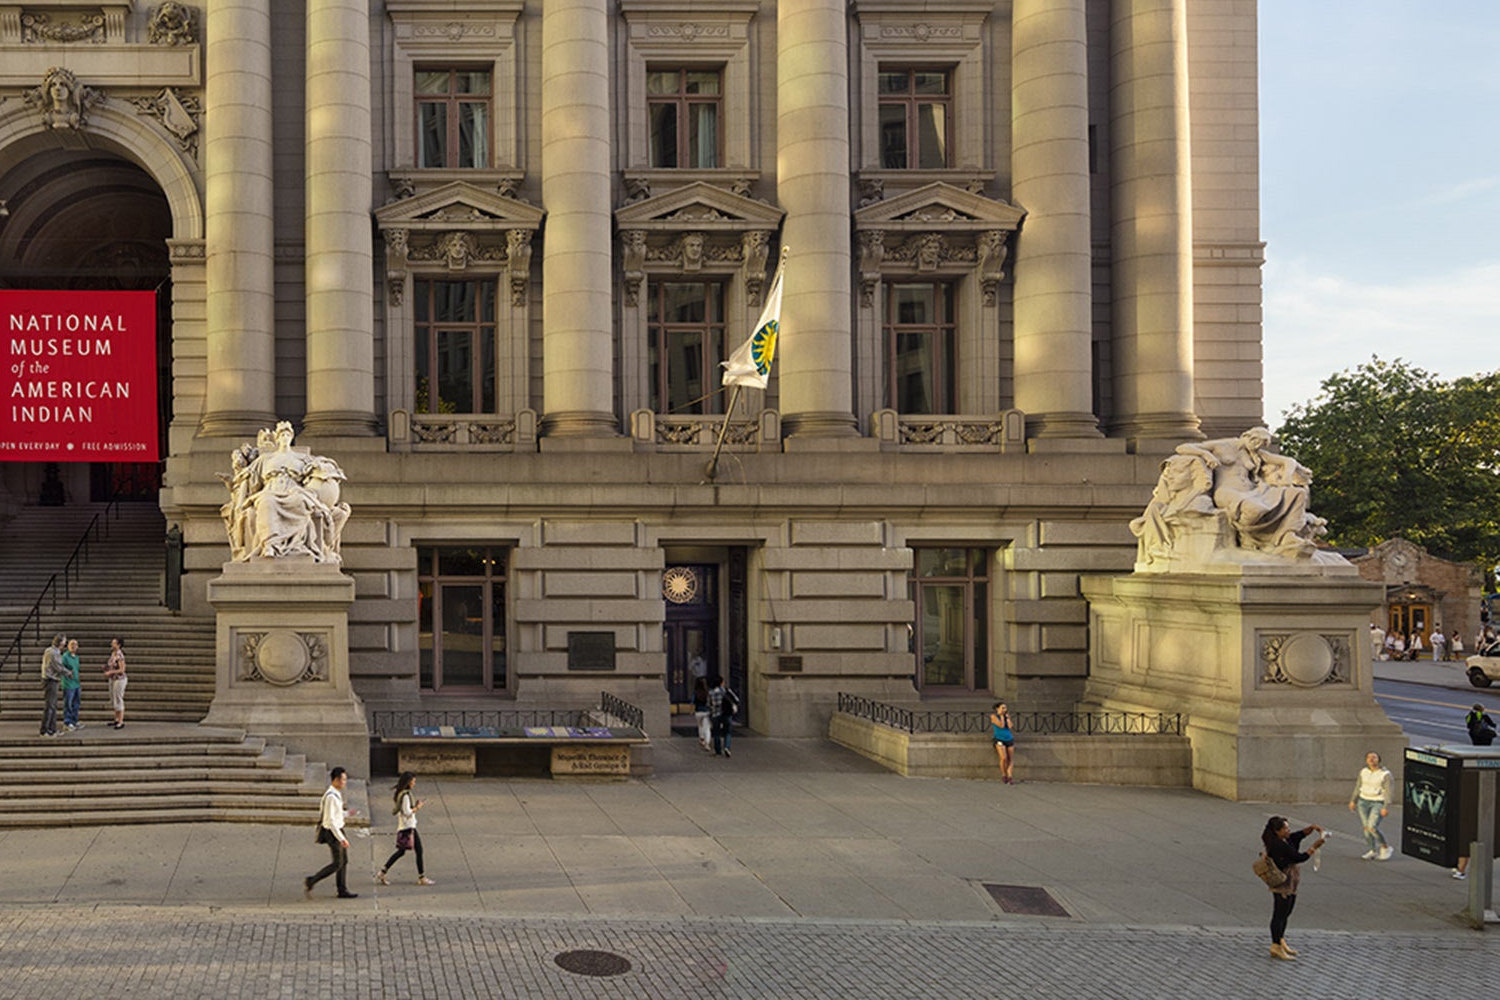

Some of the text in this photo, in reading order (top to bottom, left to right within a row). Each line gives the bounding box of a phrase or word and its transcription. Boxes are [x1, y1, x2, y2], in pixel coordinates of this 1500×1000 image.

[9, 314, 127, 332] NATIONAL
[10, 338, 112, 356] MUSEUM
[11, 360, 50, 378] of the
[11, 381, 130, 399] AMERICAN
[12, 405, 93, 423] INDIAN
[82, 441, 101, 451] FREE
[103, 442, 147, 451] ADMISSION
